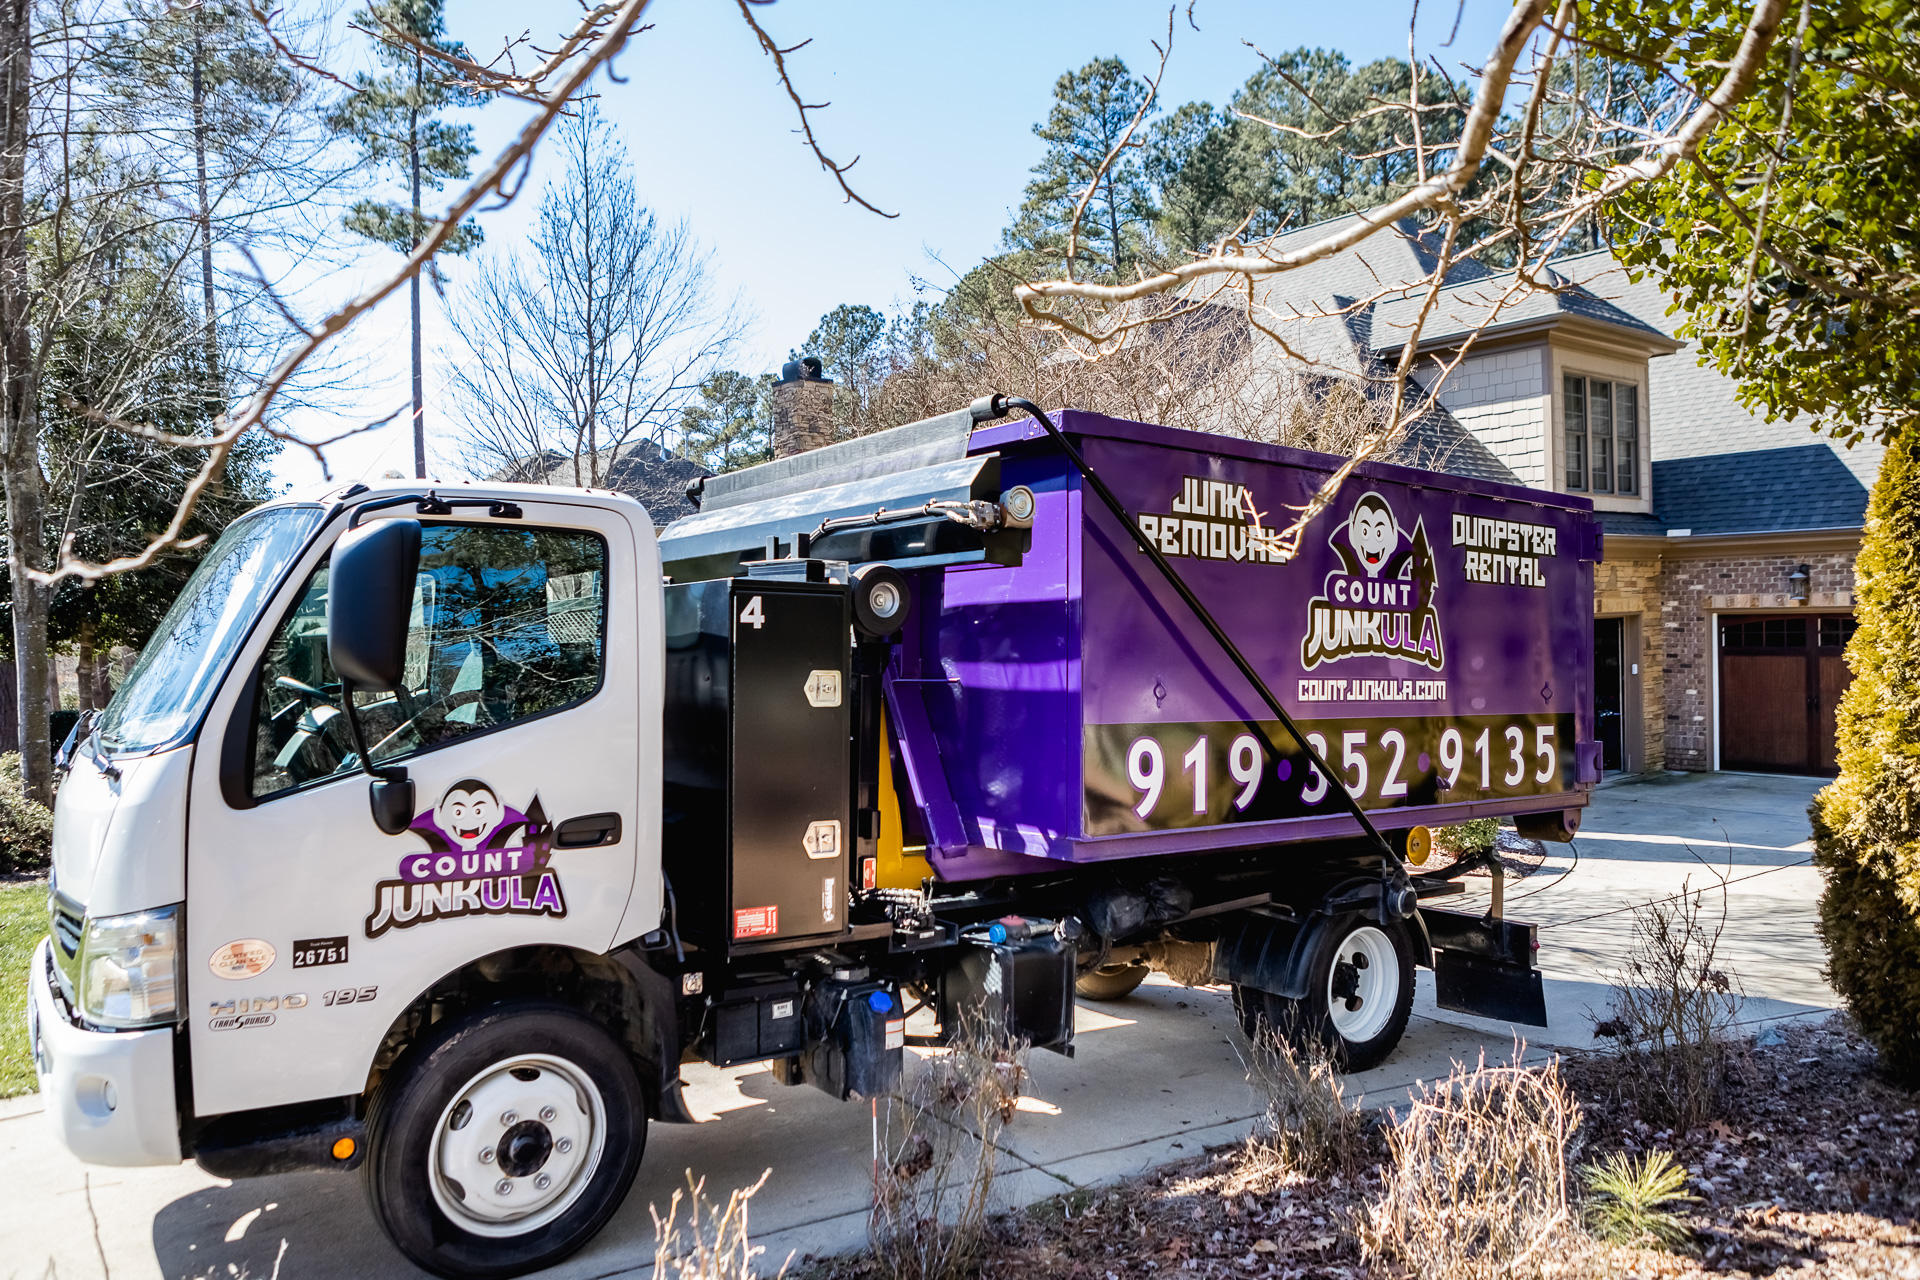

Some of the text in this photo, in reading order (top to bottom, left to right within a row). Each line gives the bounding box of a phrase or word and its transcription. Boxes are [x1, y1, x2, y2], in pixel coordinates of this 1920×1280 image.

[1172, 477, 1245, 520] JUNK
[1452, 513, 1556, 556] DUMPSTER
[1464, 550, 1546, 587] RENTAL
[1334, 579, 1411, 606] COUNT
[739, 595, 766, 630] 4
[1308, 607, 1439, 661] JUNKULA
[1298, 679, 1447, 701] COUNTJUNKULA.COM
[1127, 725, 1556, 821] 919 352 9135
[411, 850, 523, 878] COUNT
[371, 872, 562, 932] JUNKULA
[294, 946, 347, 967] 26751
[209, 985, 379, 1017] HINO 195
